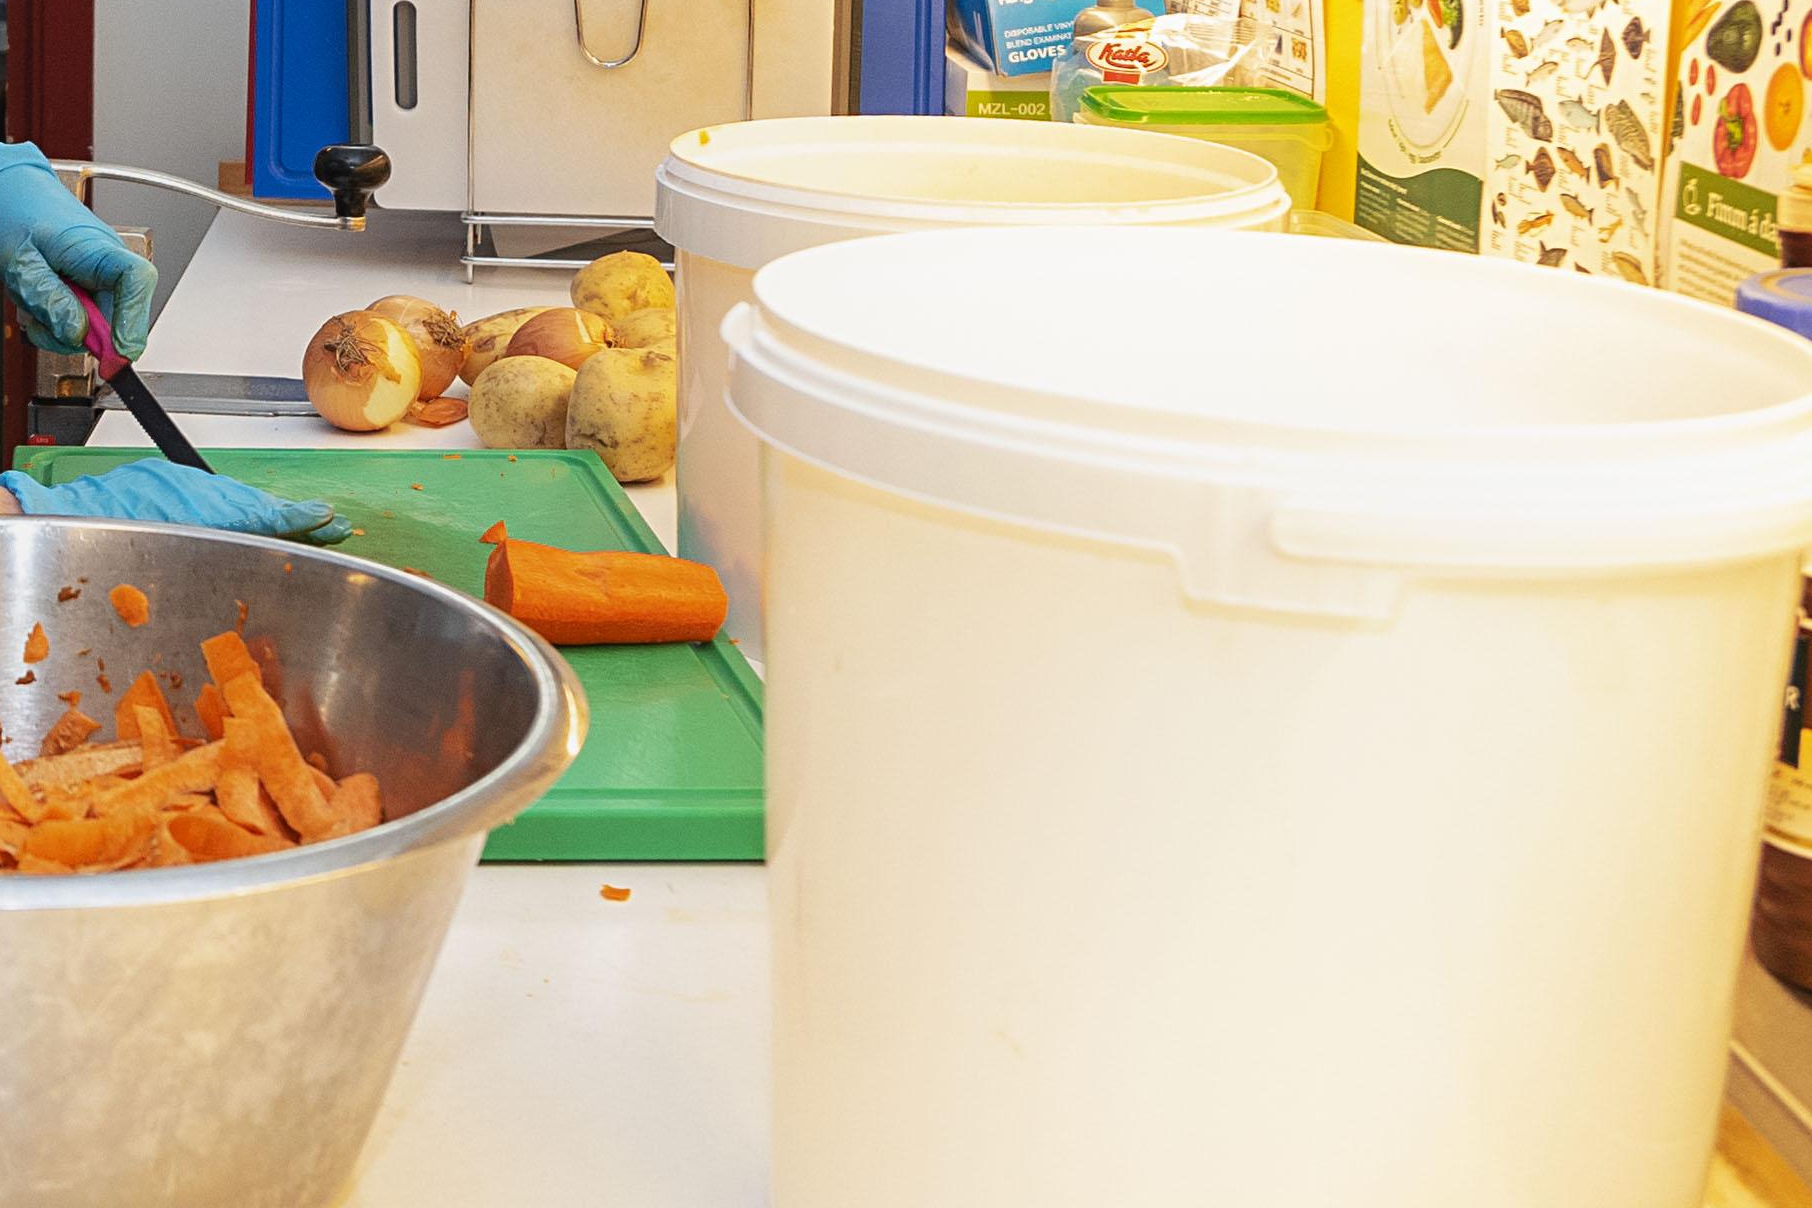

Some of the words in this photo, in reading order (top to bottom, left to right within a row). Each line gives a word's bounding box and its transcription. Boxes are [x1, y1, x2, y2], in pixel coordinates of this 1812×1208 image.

[1005, 38, 1033, 49] BLEND
[1008, 44, 1068, 63] GLOVES
[978, 103, 1046, 116] MZL-002
